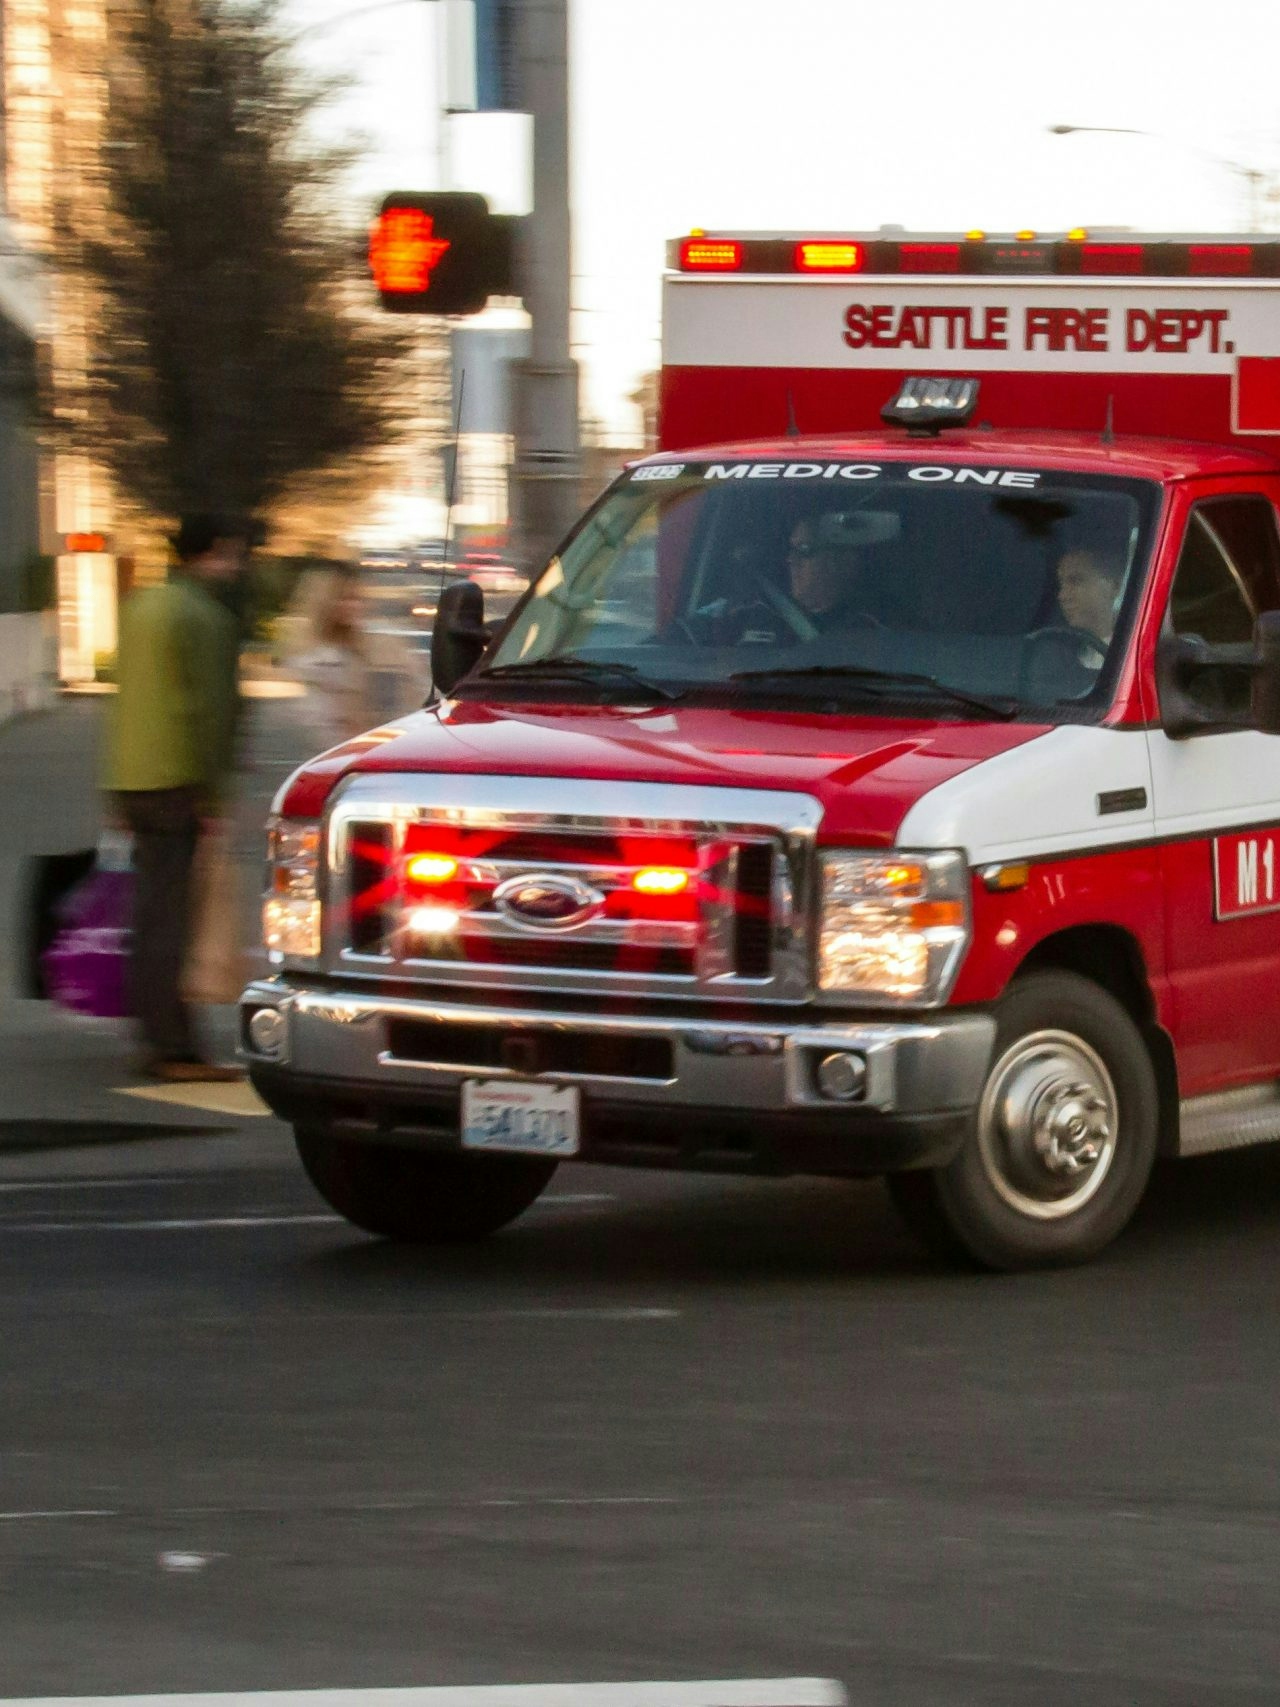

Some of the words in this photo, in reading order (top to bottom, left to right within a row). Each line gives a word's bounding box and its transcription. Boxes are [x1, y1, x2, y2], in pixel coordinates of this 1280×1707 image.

[842, 303, 1008, 350] SEATTLE
[1024, 306, 1109, 353] FIRE
[1125, 308, 1235, 354] DEPT.
[703, 463, 882, 480] MEDIC
[907, 465, 1041, 489] ONE
[1237, 838, 1275, 905] M1
